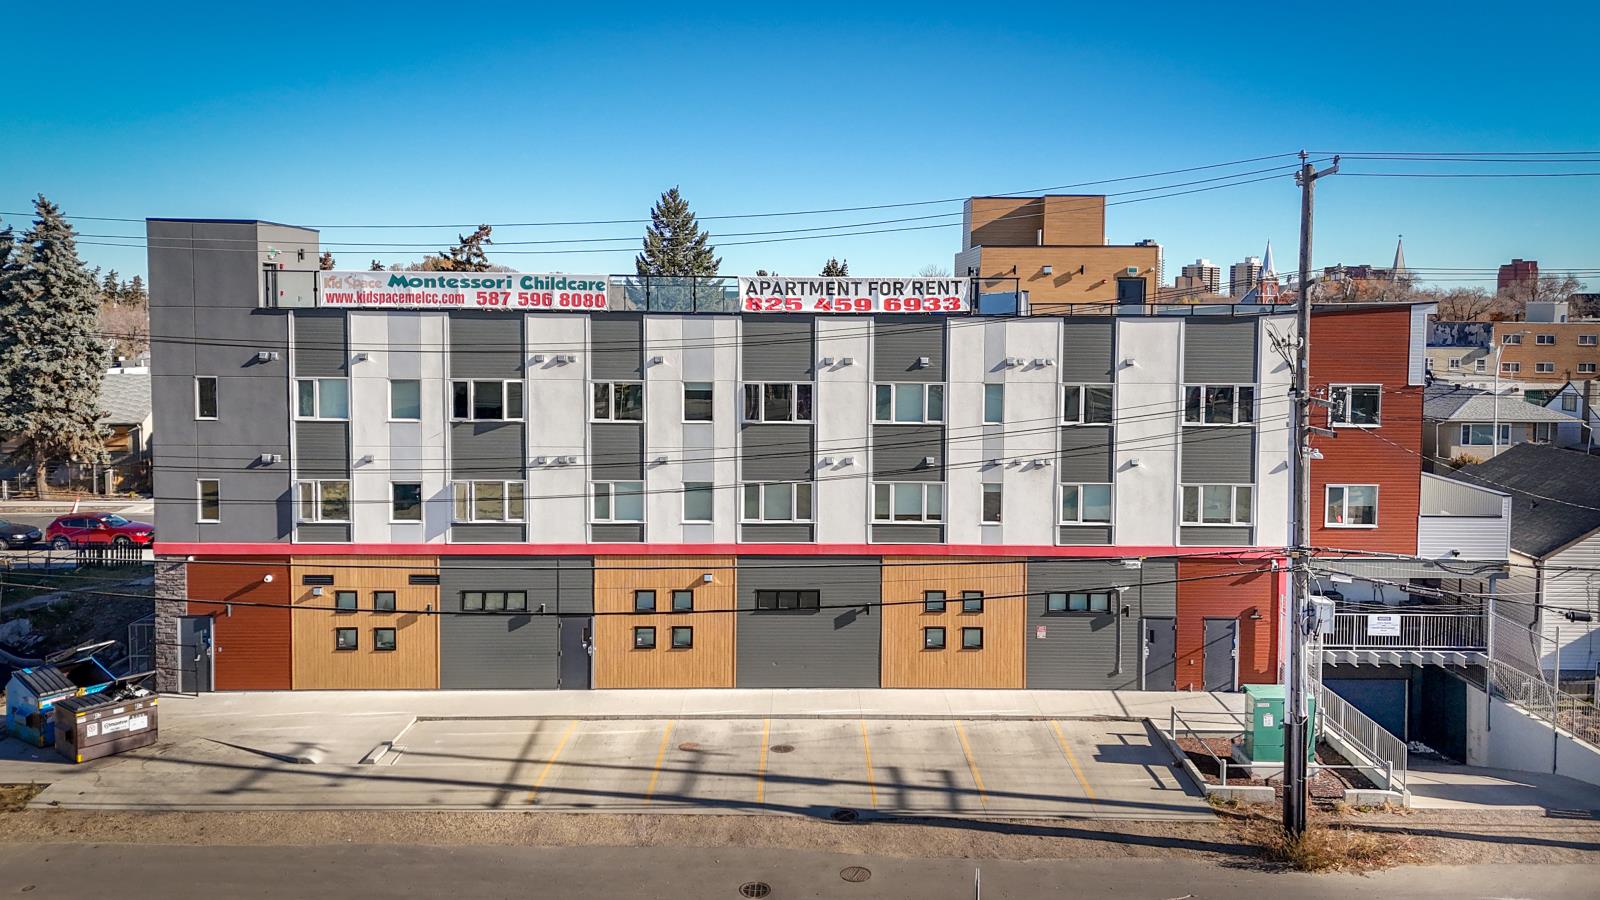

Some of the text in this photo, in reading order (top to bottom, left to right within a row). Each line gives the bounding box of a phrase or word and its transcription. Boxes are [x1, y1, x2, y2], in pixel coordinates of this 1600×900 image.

[388, 273, 512, 289] Montessori
[520, 275, 606, 291] Childcare
[746, 280, 962, 296] APARTMENT FOR RENT
[476, 291, 511, 306] 587
[518, 292, 552, 307] 596
[559, 292, 606, 308] 8080
[745, 297, 961, 311] 825 459 6933
